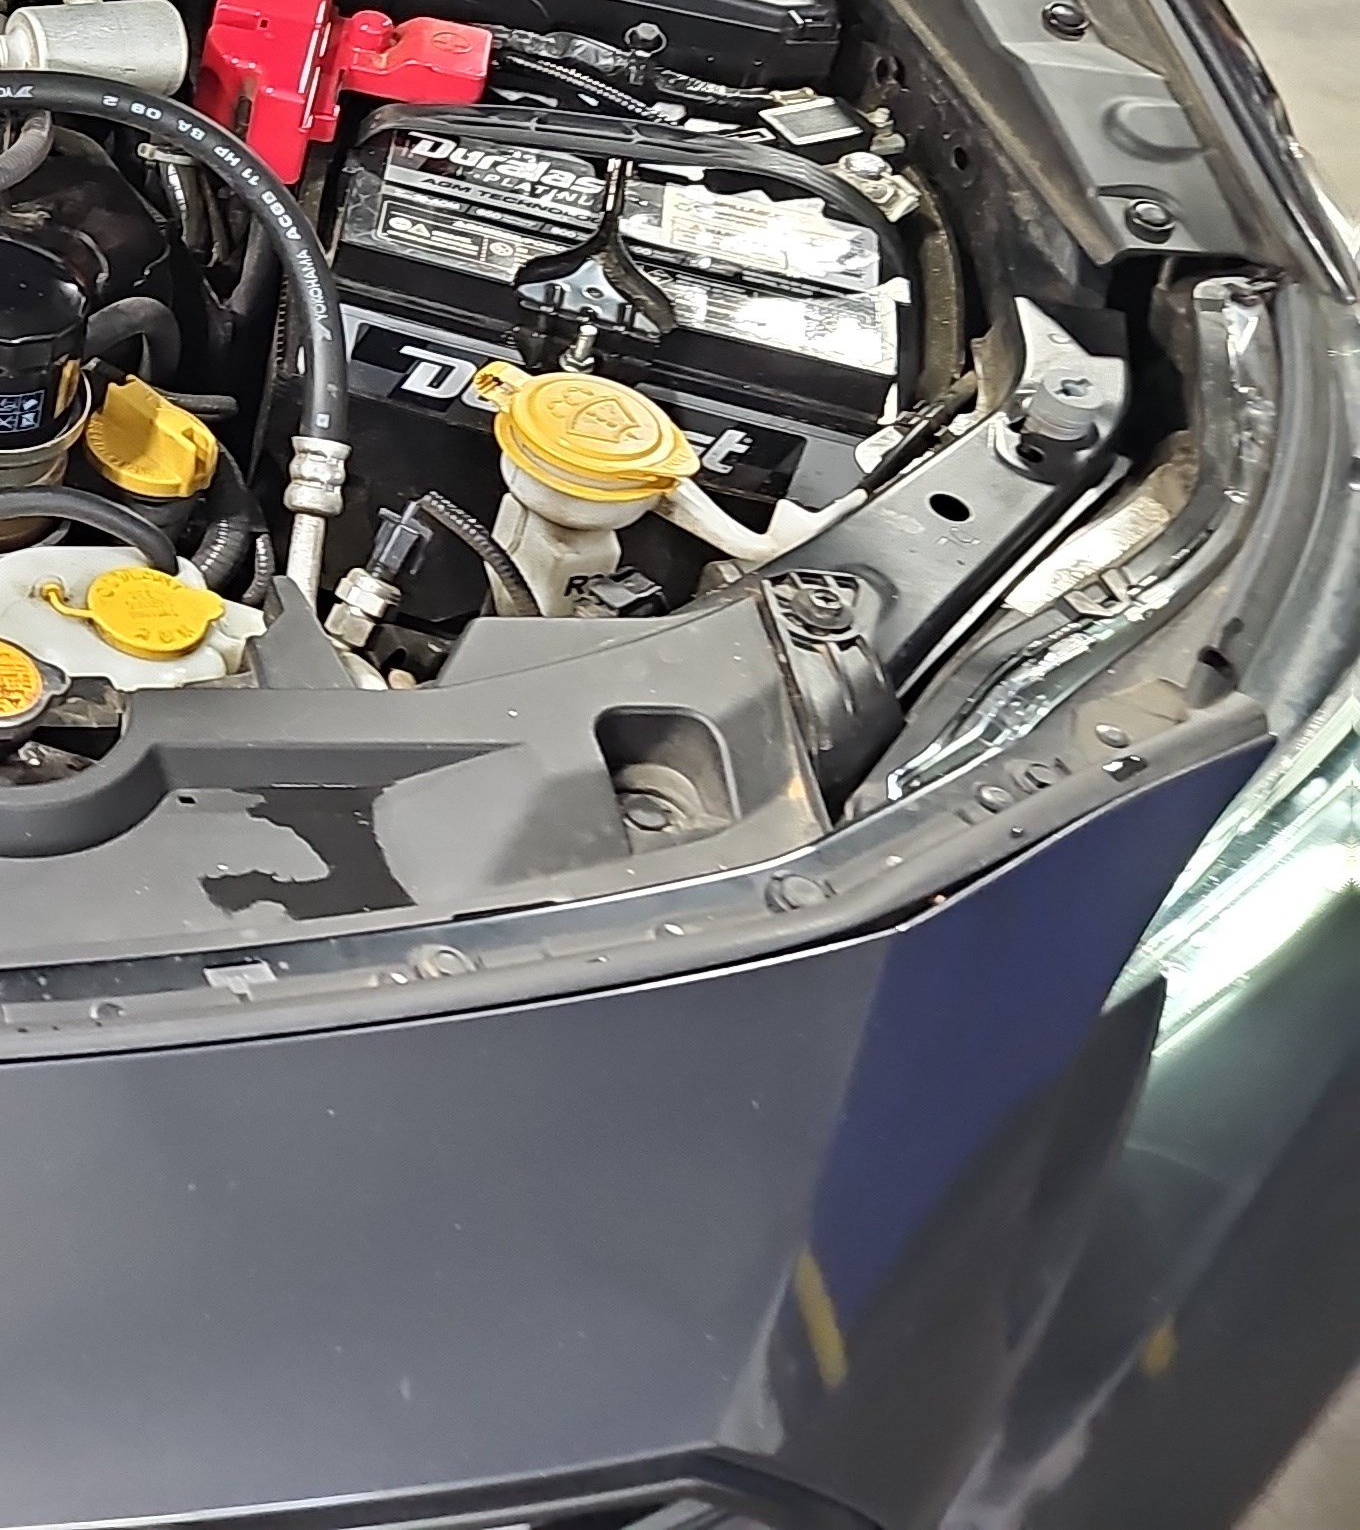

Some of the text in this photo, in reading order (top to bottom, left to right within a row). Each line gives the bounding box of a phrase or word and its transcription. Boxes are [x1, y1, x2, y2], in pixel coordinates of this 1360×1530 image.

[213, 146, 241, 167] HP
[408, 131, 607, 194] Duralas
[420, 177, 472, 193] AGM
[482, 173, 595, 206] PLATINU
[295, 248, 330, 319] YOKOHAMA
